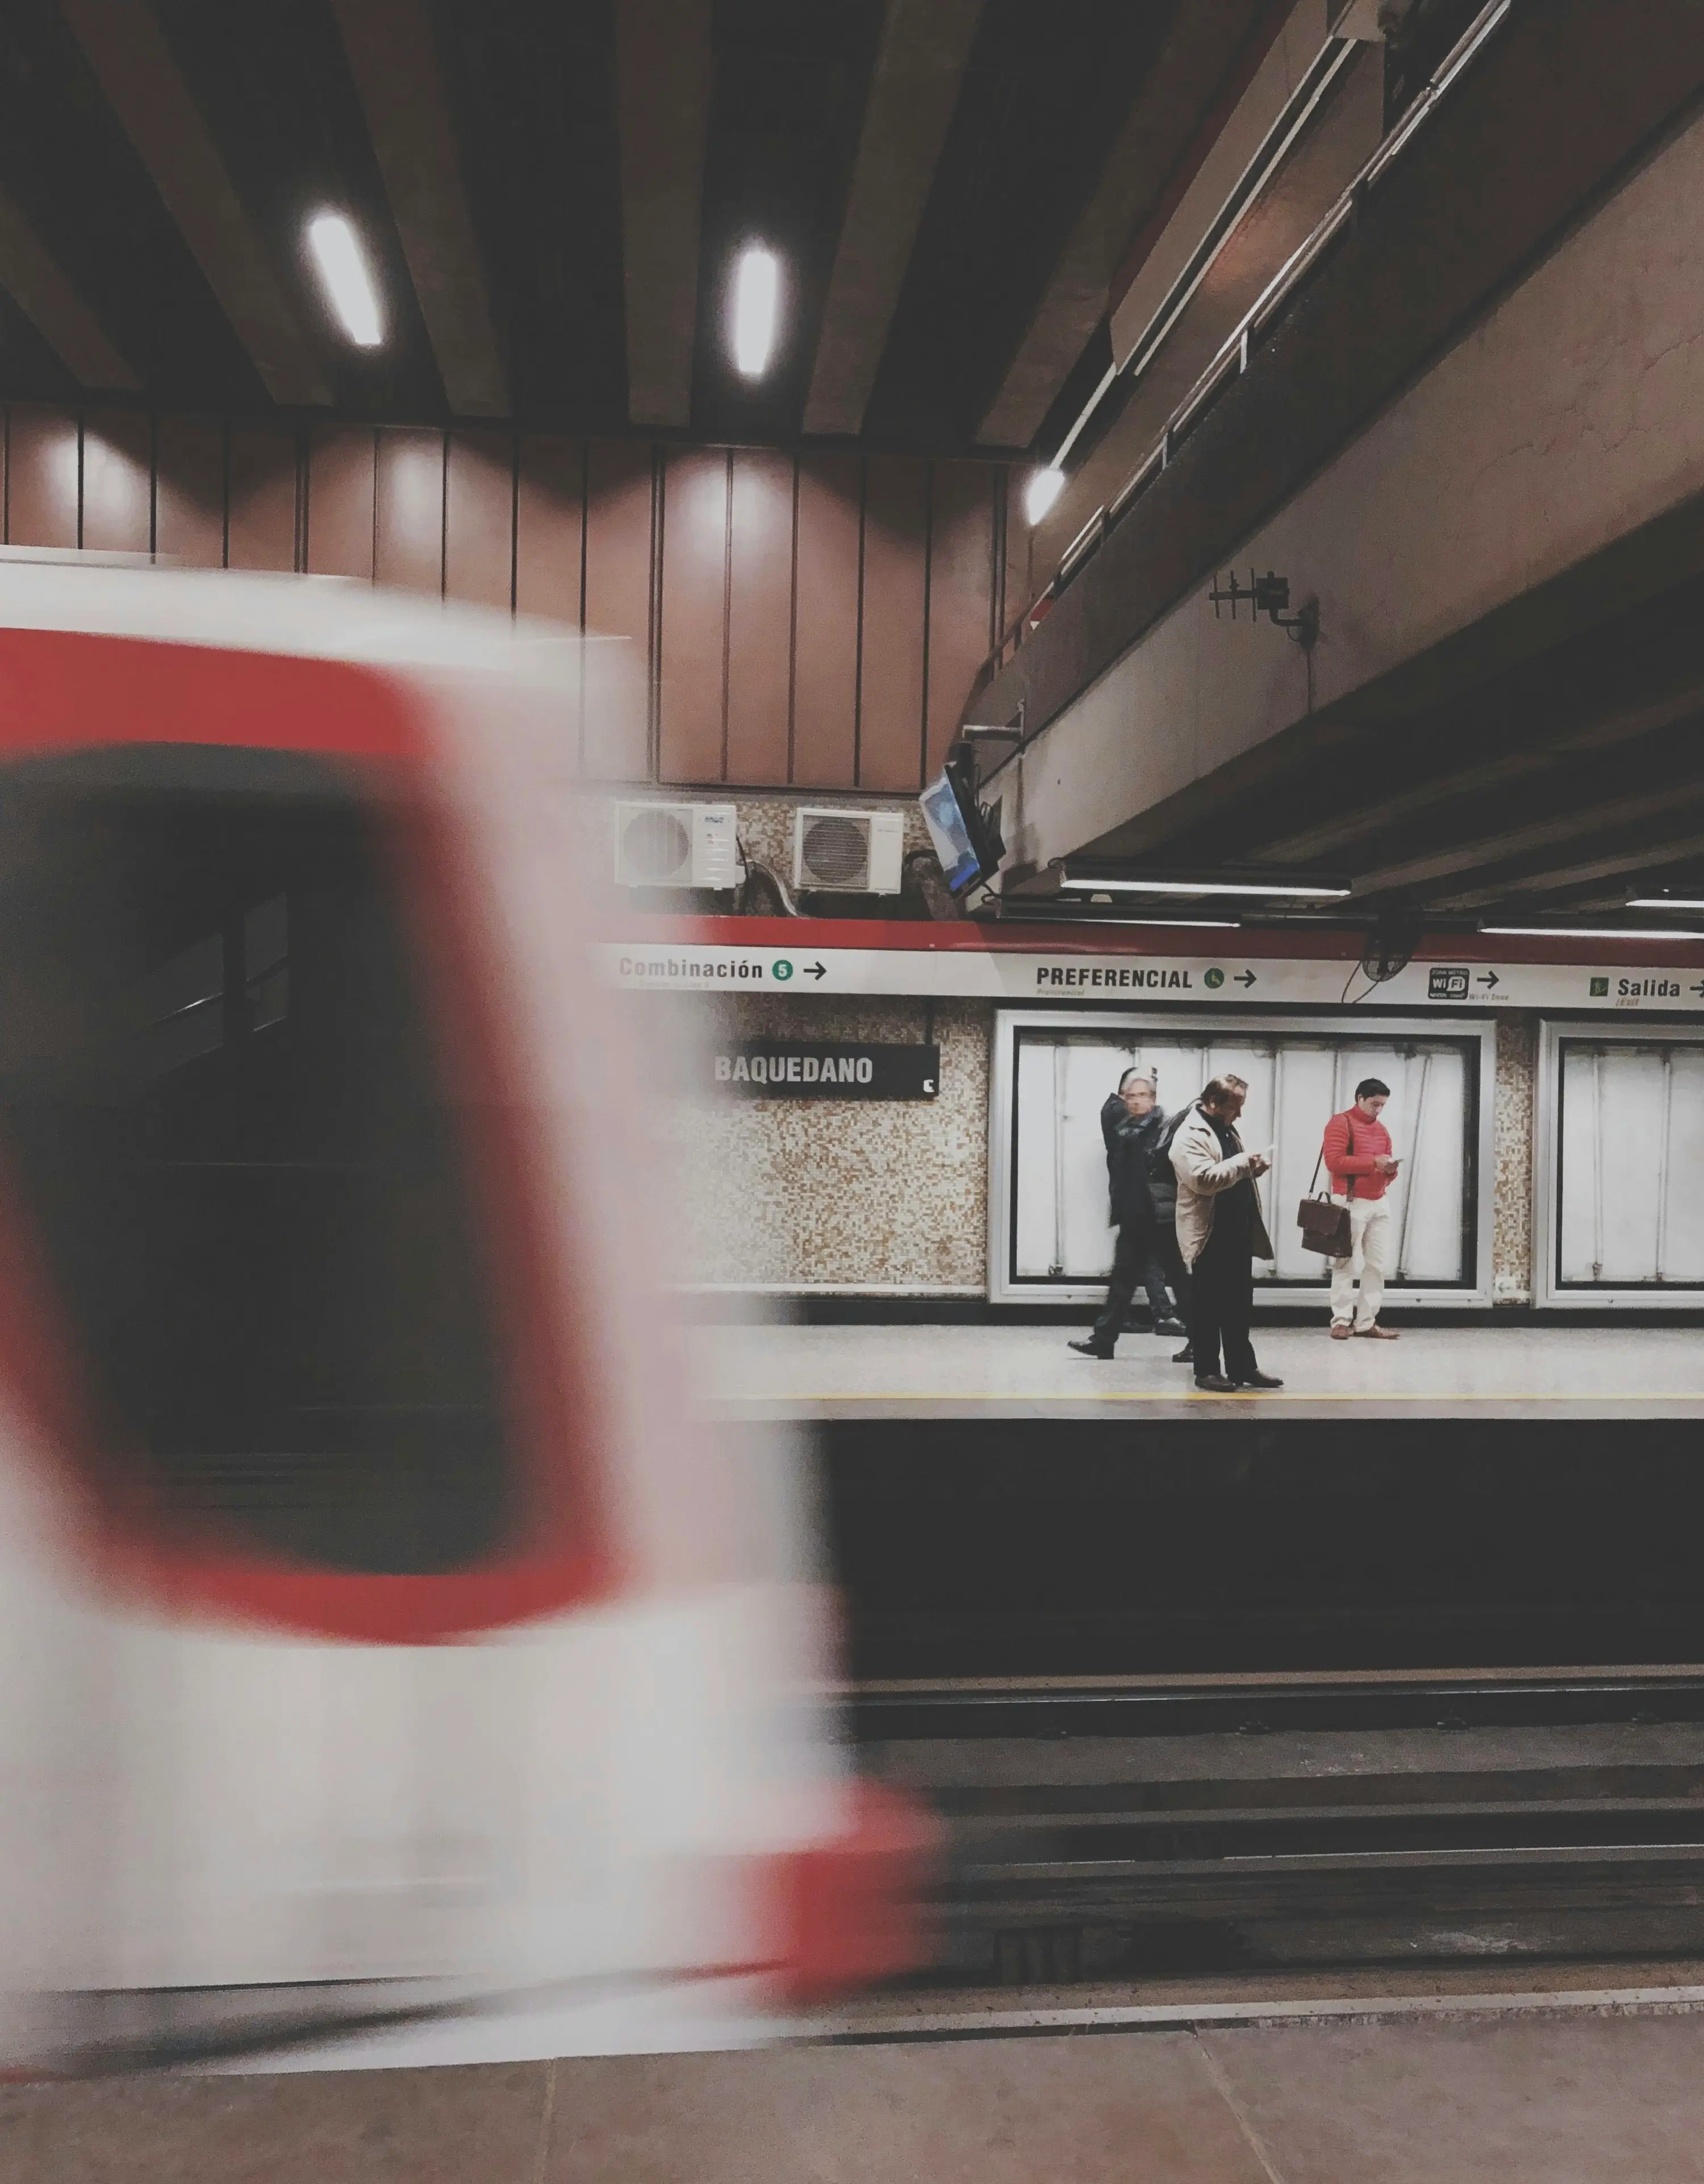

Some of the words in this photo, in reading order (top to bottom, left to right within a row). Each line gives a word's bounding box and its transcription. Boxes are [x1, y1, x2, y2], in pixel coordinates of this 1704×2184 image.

[619, 957, 763, 979] Combinación
[1037, 967, 1193, 989] PREFERENCIAL
[1618, 978, 1680, 997] Salida
[715, 1056, 873, 1084] BAQUEDANO
